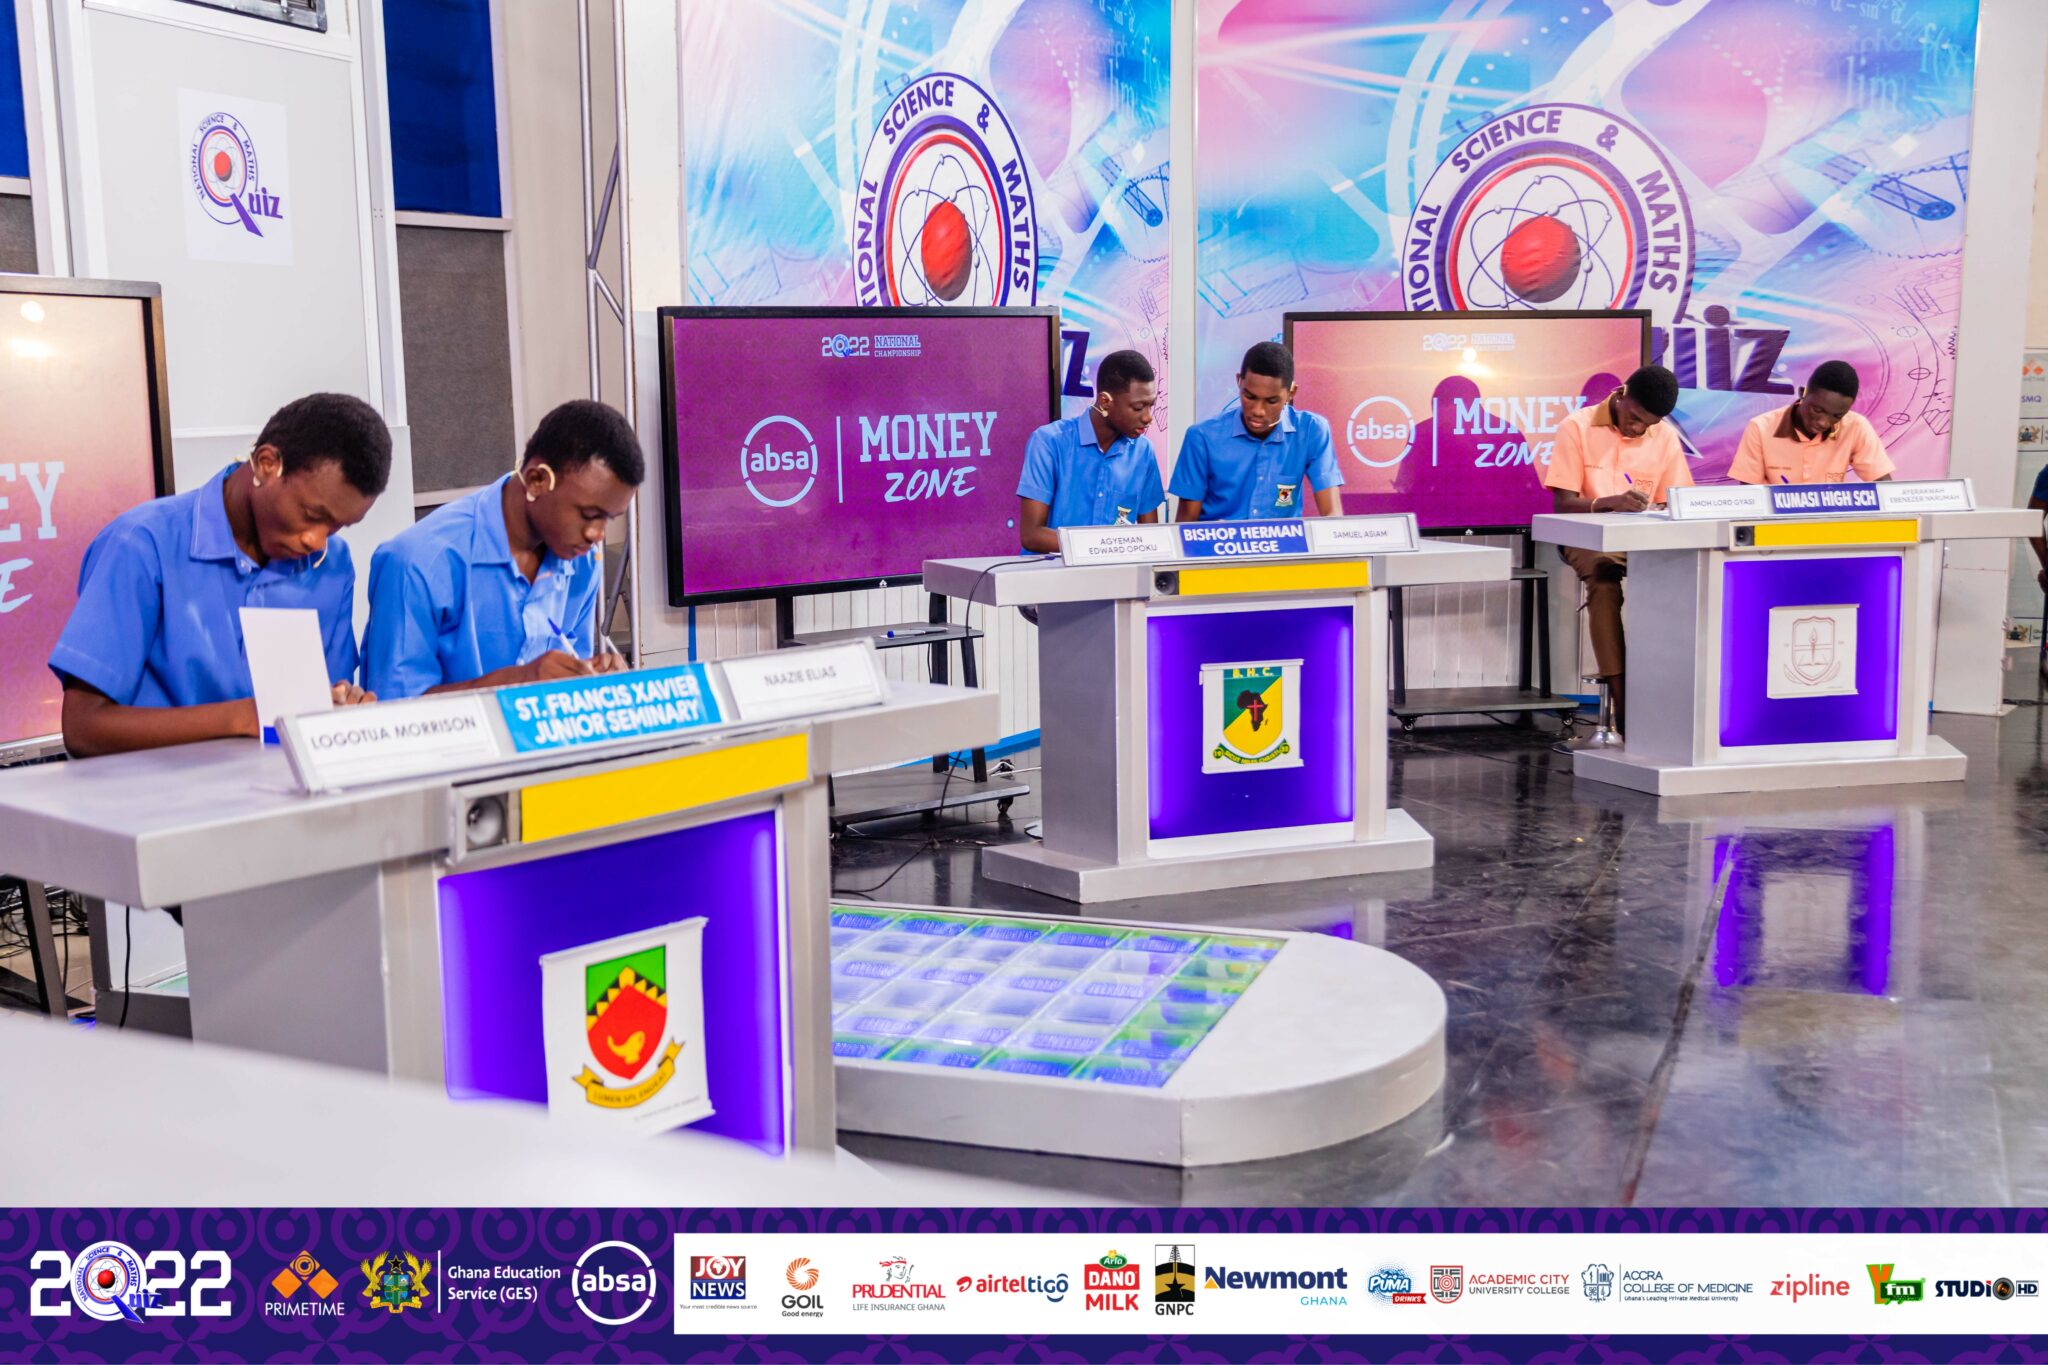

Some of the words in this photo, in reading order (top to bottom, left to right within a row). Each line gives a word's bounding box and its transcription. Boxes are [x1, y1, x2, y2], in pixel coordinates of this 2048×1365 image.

[200, 114, 225, 133] SCIENCE
[242, 140, 255, 182] MATHS
[857, 179, 879, 307] TIONAL
[883, 80, 954, 144] SCIENCE
[976, 103, 990, 134] &
[1002, 158, 1032, 293] MATHS
[1409, 203, 1443, 311] TIONAL
[1451, 110, 1563, 174] SCIENCE
[1596, 124, 1619, 152] &
[1636, 169, 1682, 295] MATHS
[874, 335, 921, 348] NATIONAL
[874, 349, 922, 358] CHAMPIONSHIP
[2021, 395, 2043, 403] SMQ
[859, 411, 998, 463] MONEY
[1355, 418, 1407, 440] absa
[751, 443, 809, 472] absa
[884, 466, 977, 503] ZONE
[1773, 491, 1821, 508] KUMASI
[1821, 490, 1853, 507] HIGH
[1853, 489, 1877, 506] SCH
[1100, 536, 1143, 546] AGYEMAN
[1183, 526, 1238, 542] BISHOP
[1239, 524, 1304, 540] HERMAN
[1332, 530, 1363, 539] SAMUEL
[1088, 546, 1125, 555] EDWARD
[1126, 543, 1157, 553] OPOKU
[1213, 540, 1280, 555] COLLEGE
[804, 665, 837, 680] ELIAS
[630, 674, 699, 703] XAVIER
[534, 714, 608, 745] JUNIOR
[605, 699, 699, 734] SEMINARY
[310, 727, 391, 750] LOGOTUA
[394, 716, 477, 739] MORRISON
